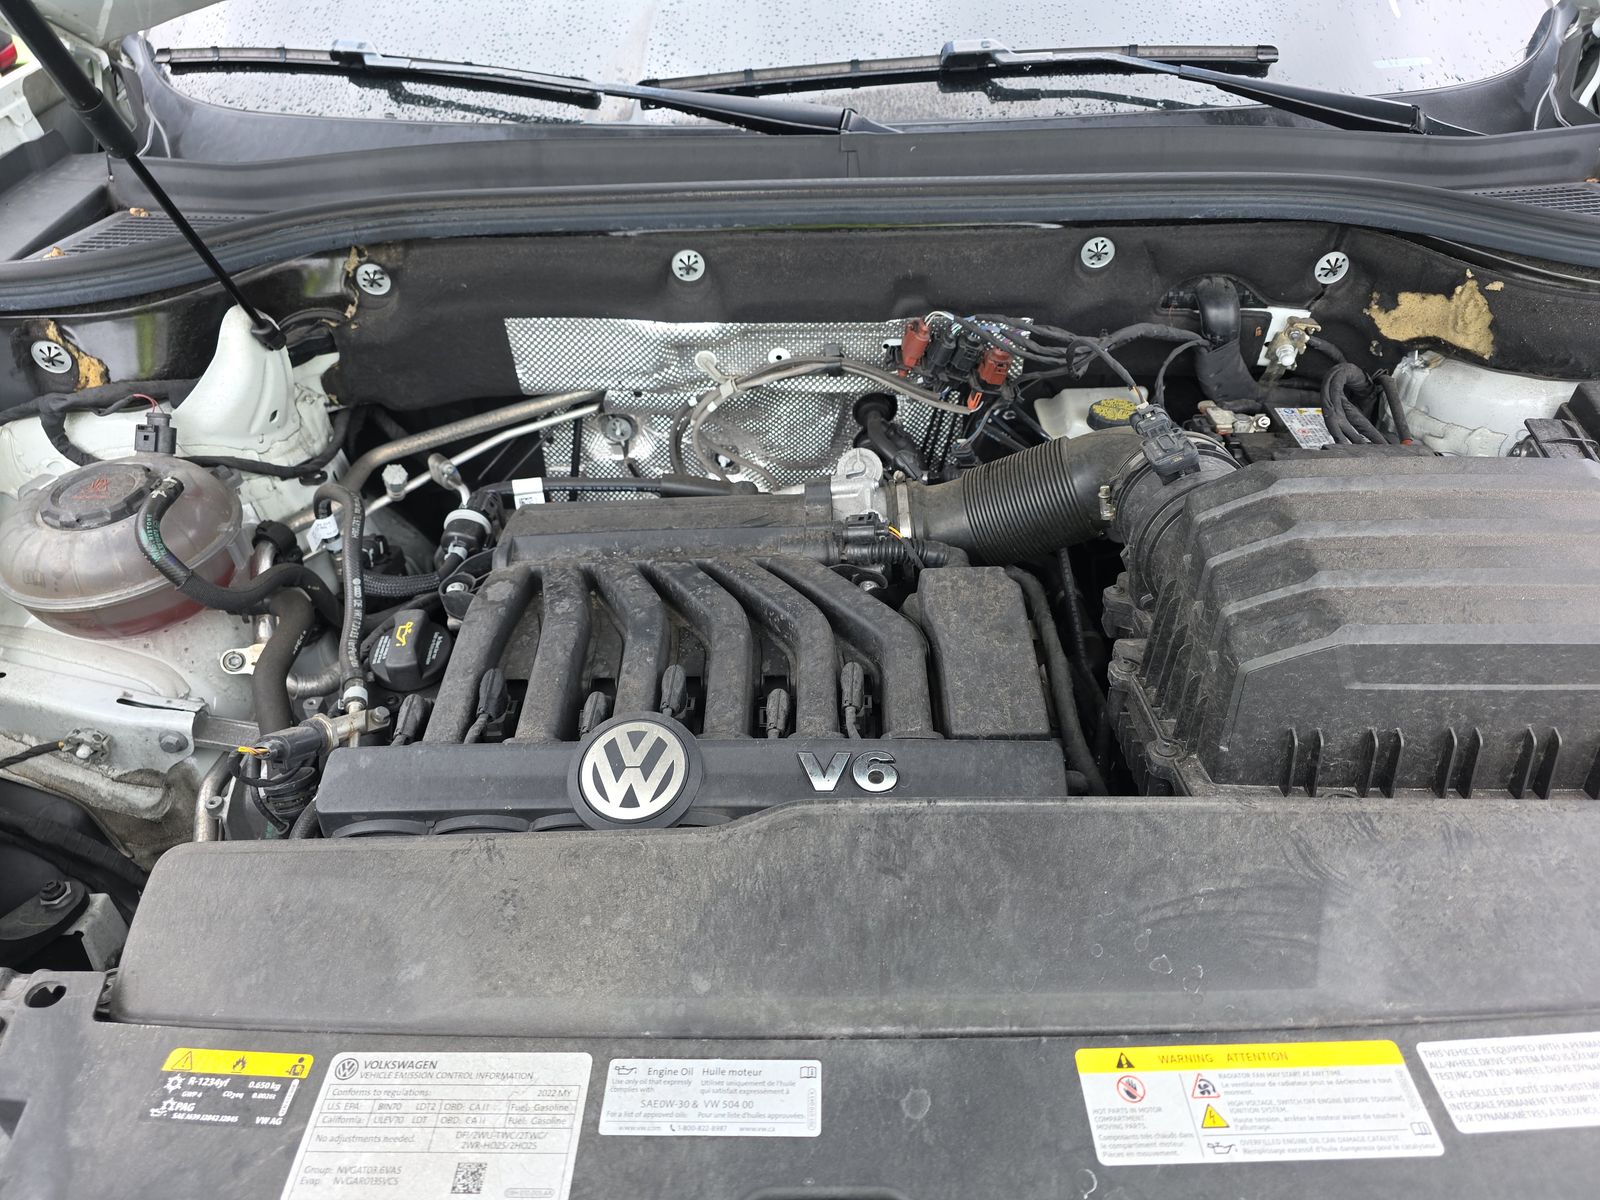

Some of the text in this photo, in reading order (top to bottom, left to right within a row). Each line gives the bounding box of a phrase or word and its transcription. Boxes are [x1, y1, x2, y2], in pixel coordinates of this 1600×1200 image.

[797, 750, 898, 793] V6
[1422, 1049, 1444, 1058] THIS
[1445, 1047, 1481, 1057] VEHICLE
[1491, 1044, 1535, 1055] EQUIPPED
[1537, 1042, 1561, 1051] WITH
[1158, 1051, 1289, 1064] WARNING ATTENTION
[1429, 1058, 1478, 1069] ALL-WHEEL
[1479, 1056, 1506, 1066] DRIVE
[1506, 1054, 1540, 1064] SYSTEM
[364, 1060, 438, 1070] VOLKSWAGEN
[360, 1071, 534, 1080] VEHICLE EMISSION CONTROL INFORMATION
[647, 1067, 694, 1078] Engine Oil
[702, 1067, 762, 1077] Huile moteur
[1434, 1070, 1472, 1081] TESTING
[188, 1076, 281, 1091] R-1234yf 0.650 kg
[332, 1088, 431, 1099] Conforms to regulations:
[537, 1089, 572, 1097] 2022 MY
[175, 1101, 196, 1111] PAG
[470, 1103, 481, 1111] CA
[533, 1103, 570, 1112] Gasoline
[691, 1100, 699, 1108] &
[704, 1100, 720, 1108] VW
[722, 1100, 740, 1109] 504
[742, 1100, 754, 1109] 00
[255, 1116, 283, 1125] VW AG
[466, 1116, 478, 1124] CA
[530, 1116, 567, 1125] Gasoline
[315, 1134, 328, 1143] No
[329, 1134, 381, 1145] adjustments
